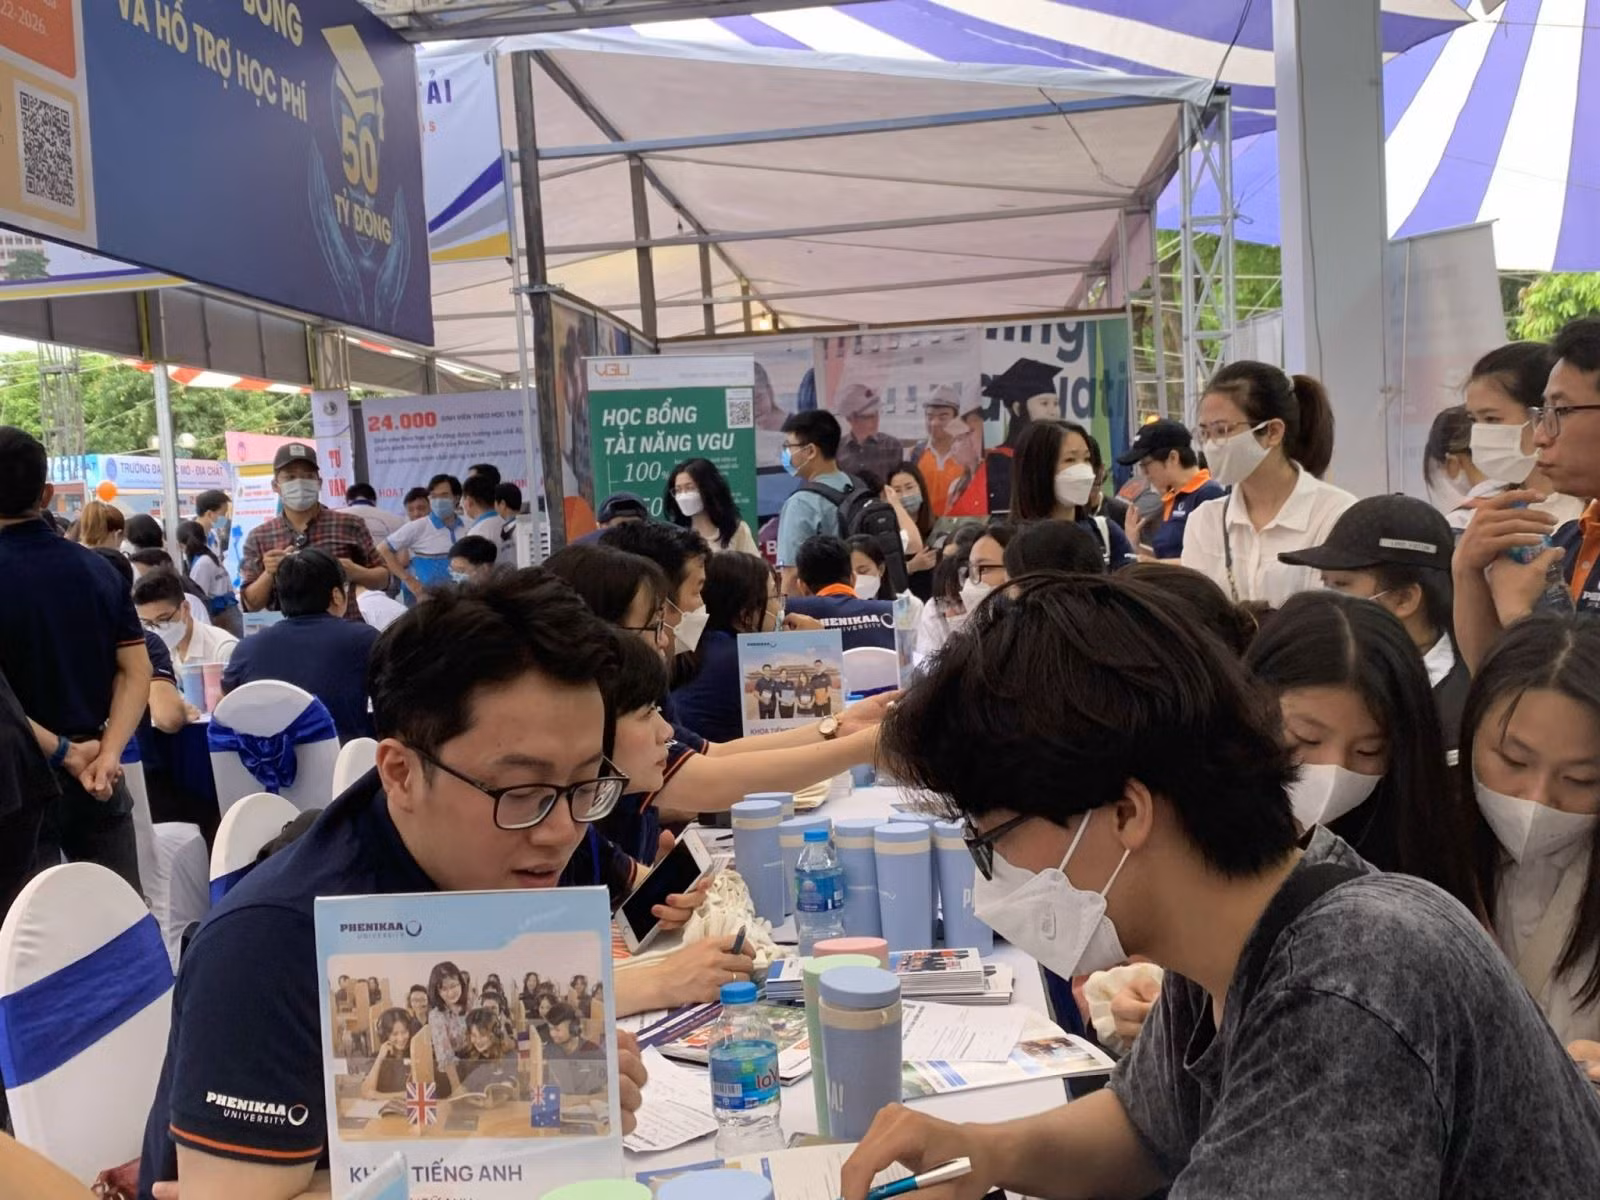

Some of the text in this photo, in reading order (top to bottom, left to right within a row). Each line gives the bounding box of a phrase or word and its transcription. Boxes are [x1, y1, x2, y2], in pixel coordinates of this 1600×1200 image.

[192, 22, 233, 90] TRỢ
[236, 49, 278, 108] HỌC
[341, 113, 379, 195] 50
[334, 187, 350, 226] TỶ
[367, 411, 437, 433] 24.000
[602, 396, 698, 430] HỌC BỔNG
[603, 430, 735, 455] TÀI NĂNG VGU
[339, 921, 404, 933] PHENIKAA
[205, 1091, 287, 1116] PHENIKAA
[222, 1108, 287, 1126] UNIVERSITY
[411, 1157, 474, 1183] TIẾNG
[478, 1164, 522, 1182] ANH
